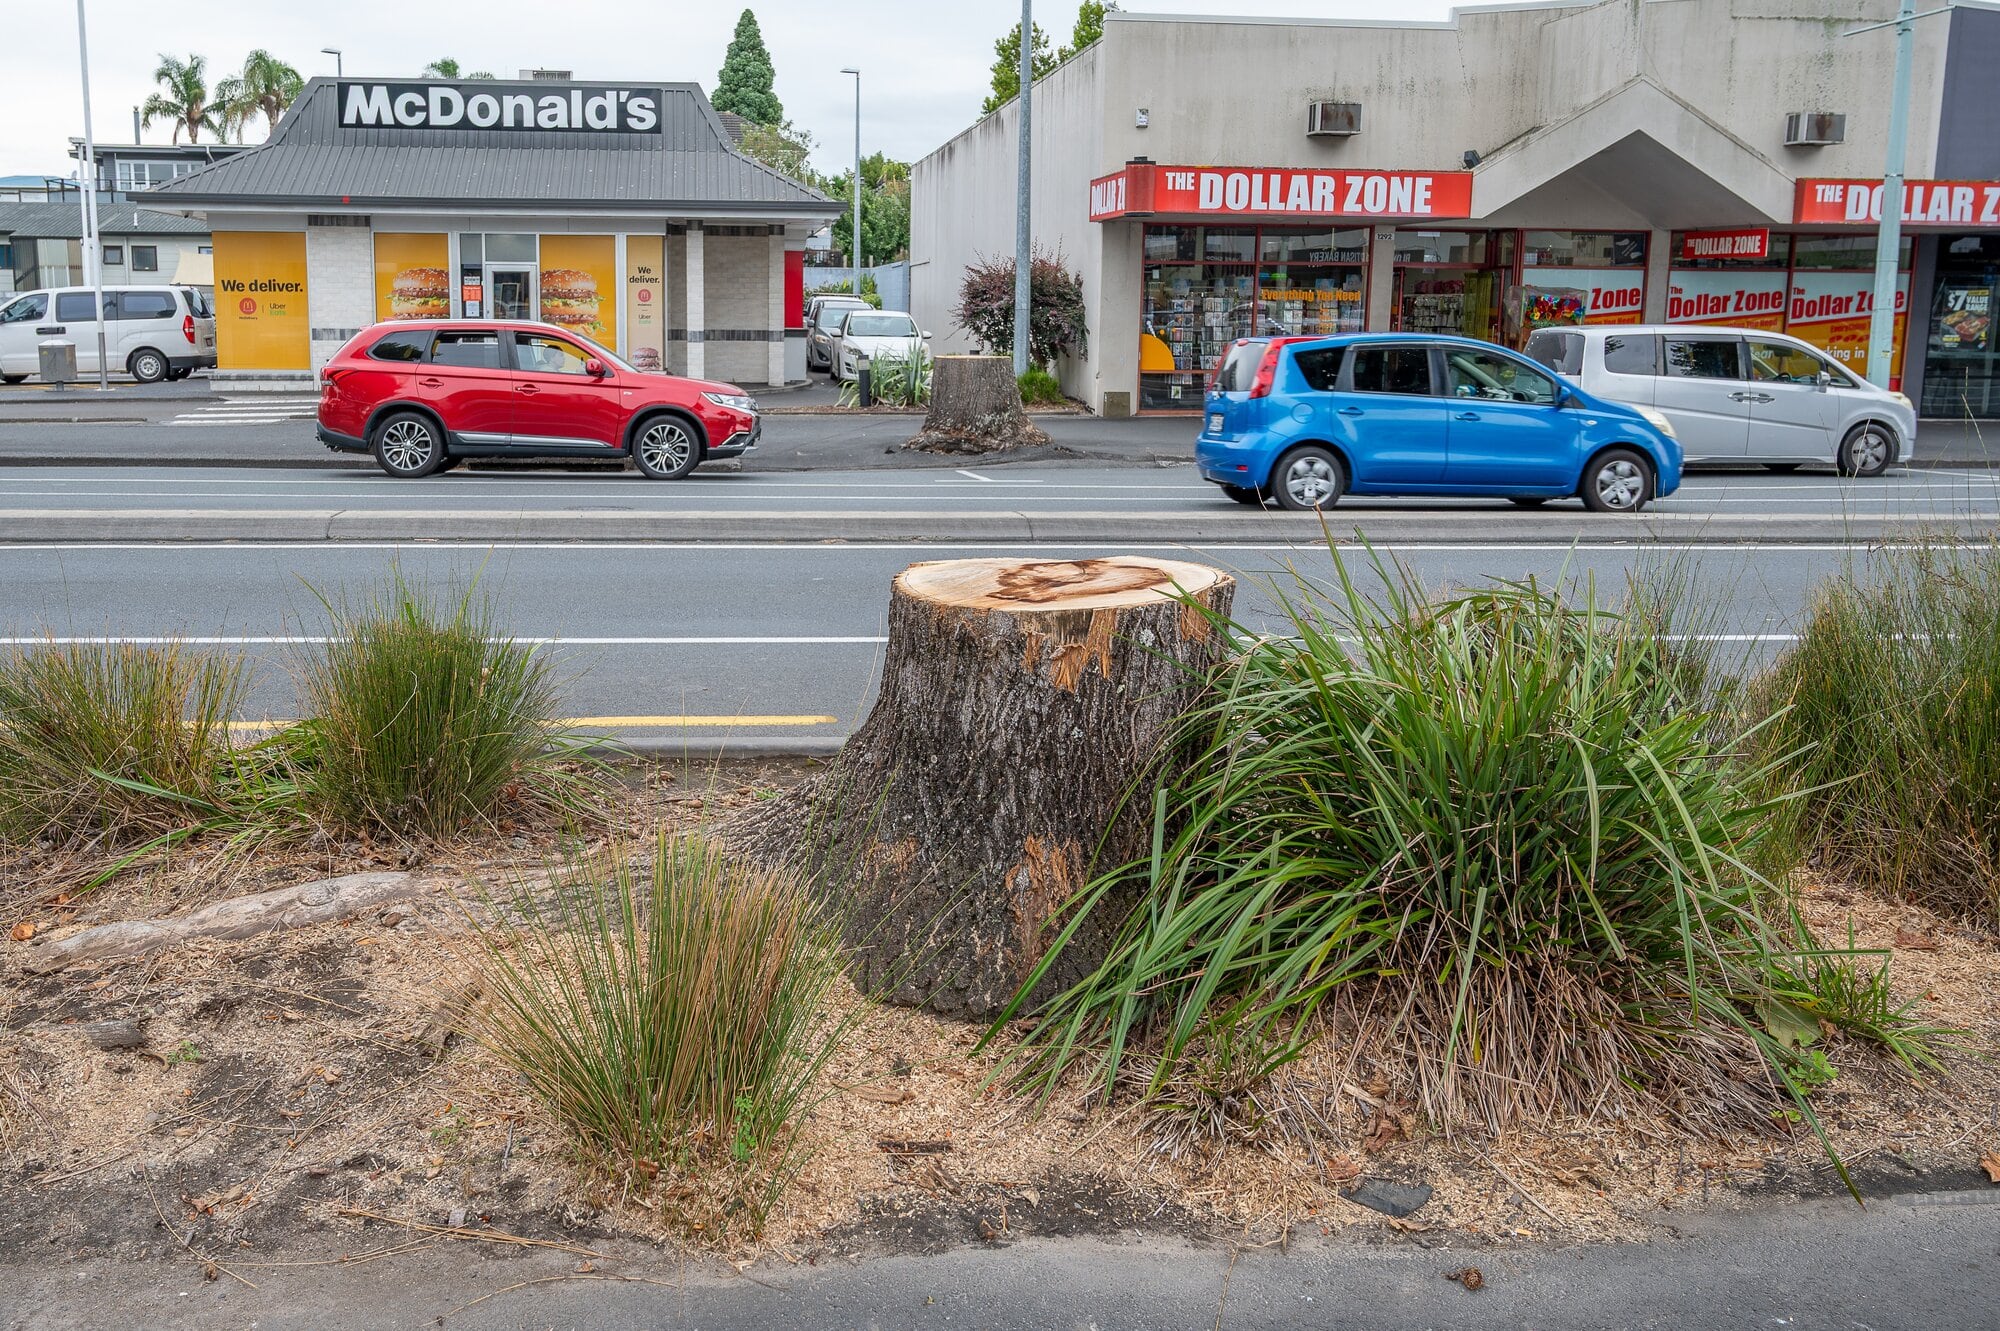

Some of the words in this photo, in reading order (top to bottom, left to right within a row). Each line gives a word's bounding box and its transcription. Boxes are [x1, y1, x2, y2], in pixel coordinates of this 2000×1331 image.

[343, 85, 657, 130] McDonald's
[1091, 180, 1117, 217] DOLLAR
[1165, 171, 1195, 190] THE
[1199, 172, 1336, 212] DOLLAR
[1343, 175, 1433, 213] ZONE
[1815, 184, 1844, 203] THE
[1979, 187, 2000, 223] Z
[1376, 233, 1393, 241] 1292
[1687, 238, 1696, 248] THE
[1694, 236, 1733, 256] DOLLAR
[1733, 235, 1762, 254] ZONE
[629, 275, 660, 284] deliver.
[637, 266, 651, 274] We
[221, 279, 245, 292] We
[248, 279, 303, 292] deliver.
[1261, 289, 1315, 303] Everything
[1316, 289, 1334, 301] You
[1335, 288, 1361, 302] Need
[1670, 286, 1683, 295] The
[1793, 287, 1806, 296] The
[1590, 287, 1641, 310] Zone
[1668, 293, 1731, 319] Dollar
[1733, 290, 1783, 313] Zone
[1791, 294, 1853, 320] Dollar
[1947, 289, 1969, 311] $7
[1966, 295, 1989, 304] VALUE
[1854, 345, 1865, 359] in
